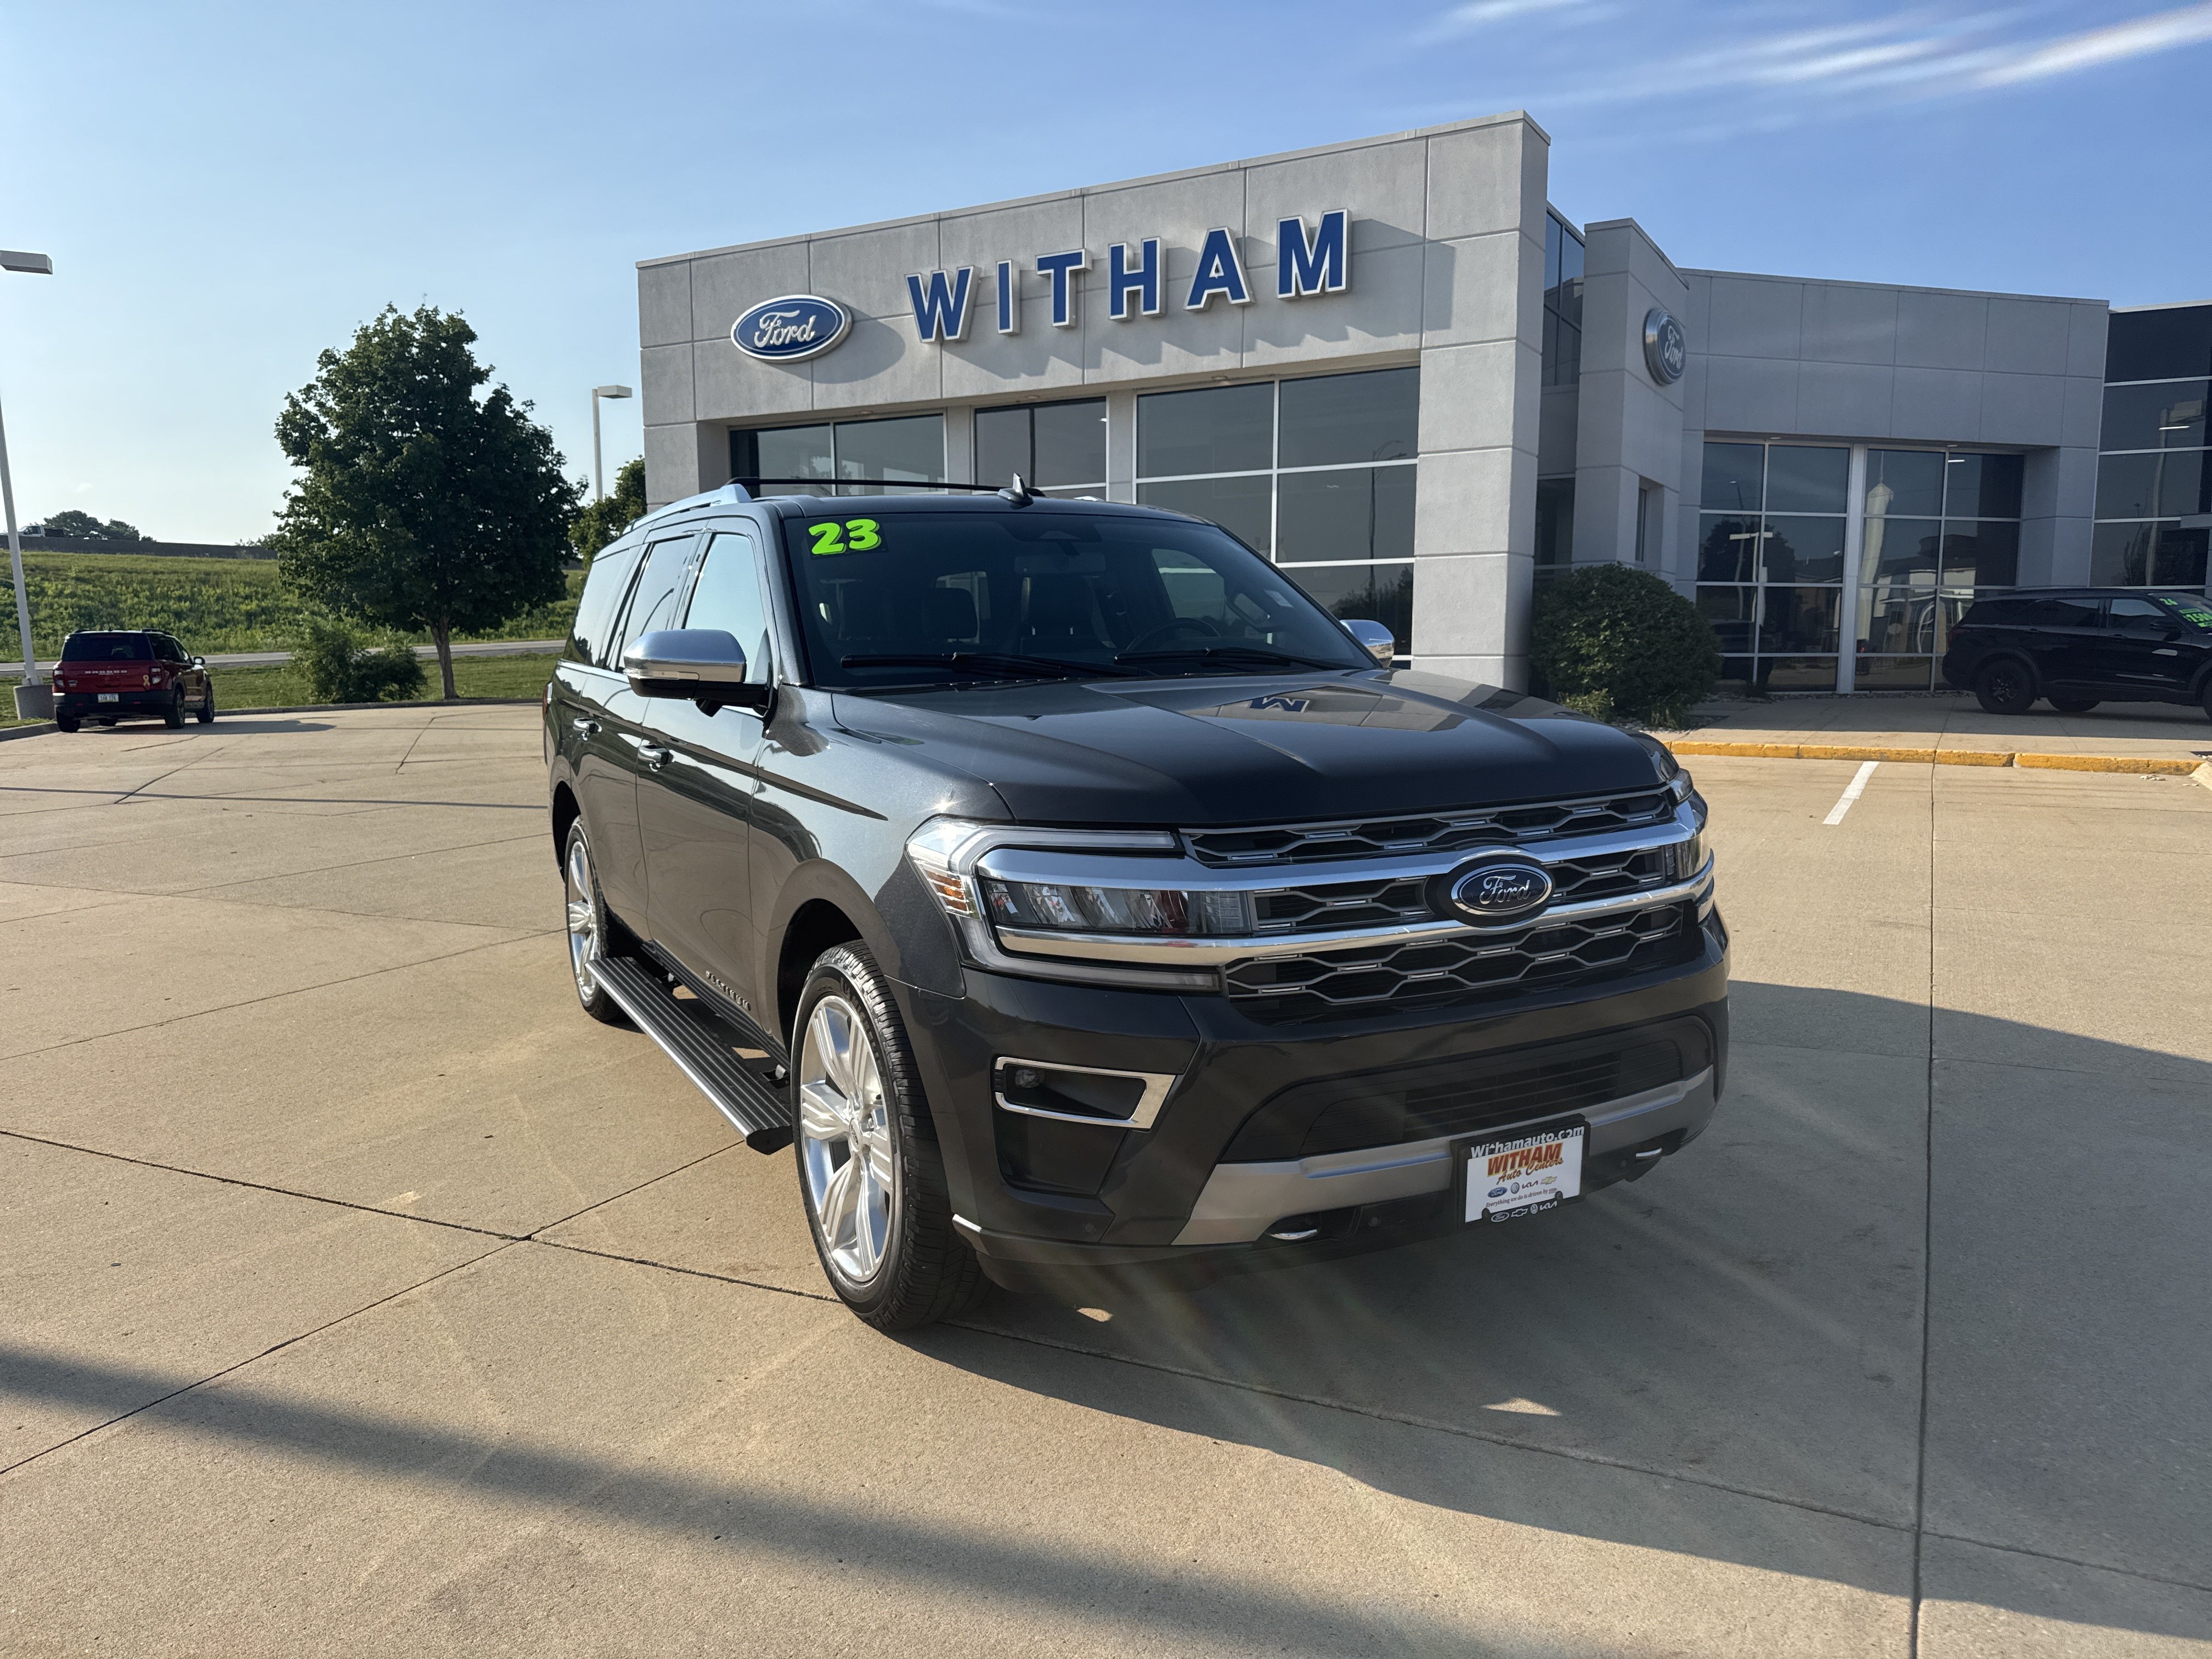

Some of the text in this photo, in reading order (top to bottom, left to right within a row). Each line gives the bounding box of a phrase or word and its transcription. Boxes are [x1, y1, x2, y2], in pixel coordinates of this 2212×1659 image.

[904, 207, 1353, 344] WITHAM
[754, 309, 817, 348] Ford
[1664, 325, 1683, 370] Ford
[808, 518, 882, 555] 23
[1480, 874, 1531, 905] Ford
[1471, 1126, 1585, 1159] Withamauto.com
[1487, 1142, 1564, 1177] WITHAM
[1496, 1156, 1564, 1186] Auto Centers
[1486, 1198, 1510, 1208] Everything
